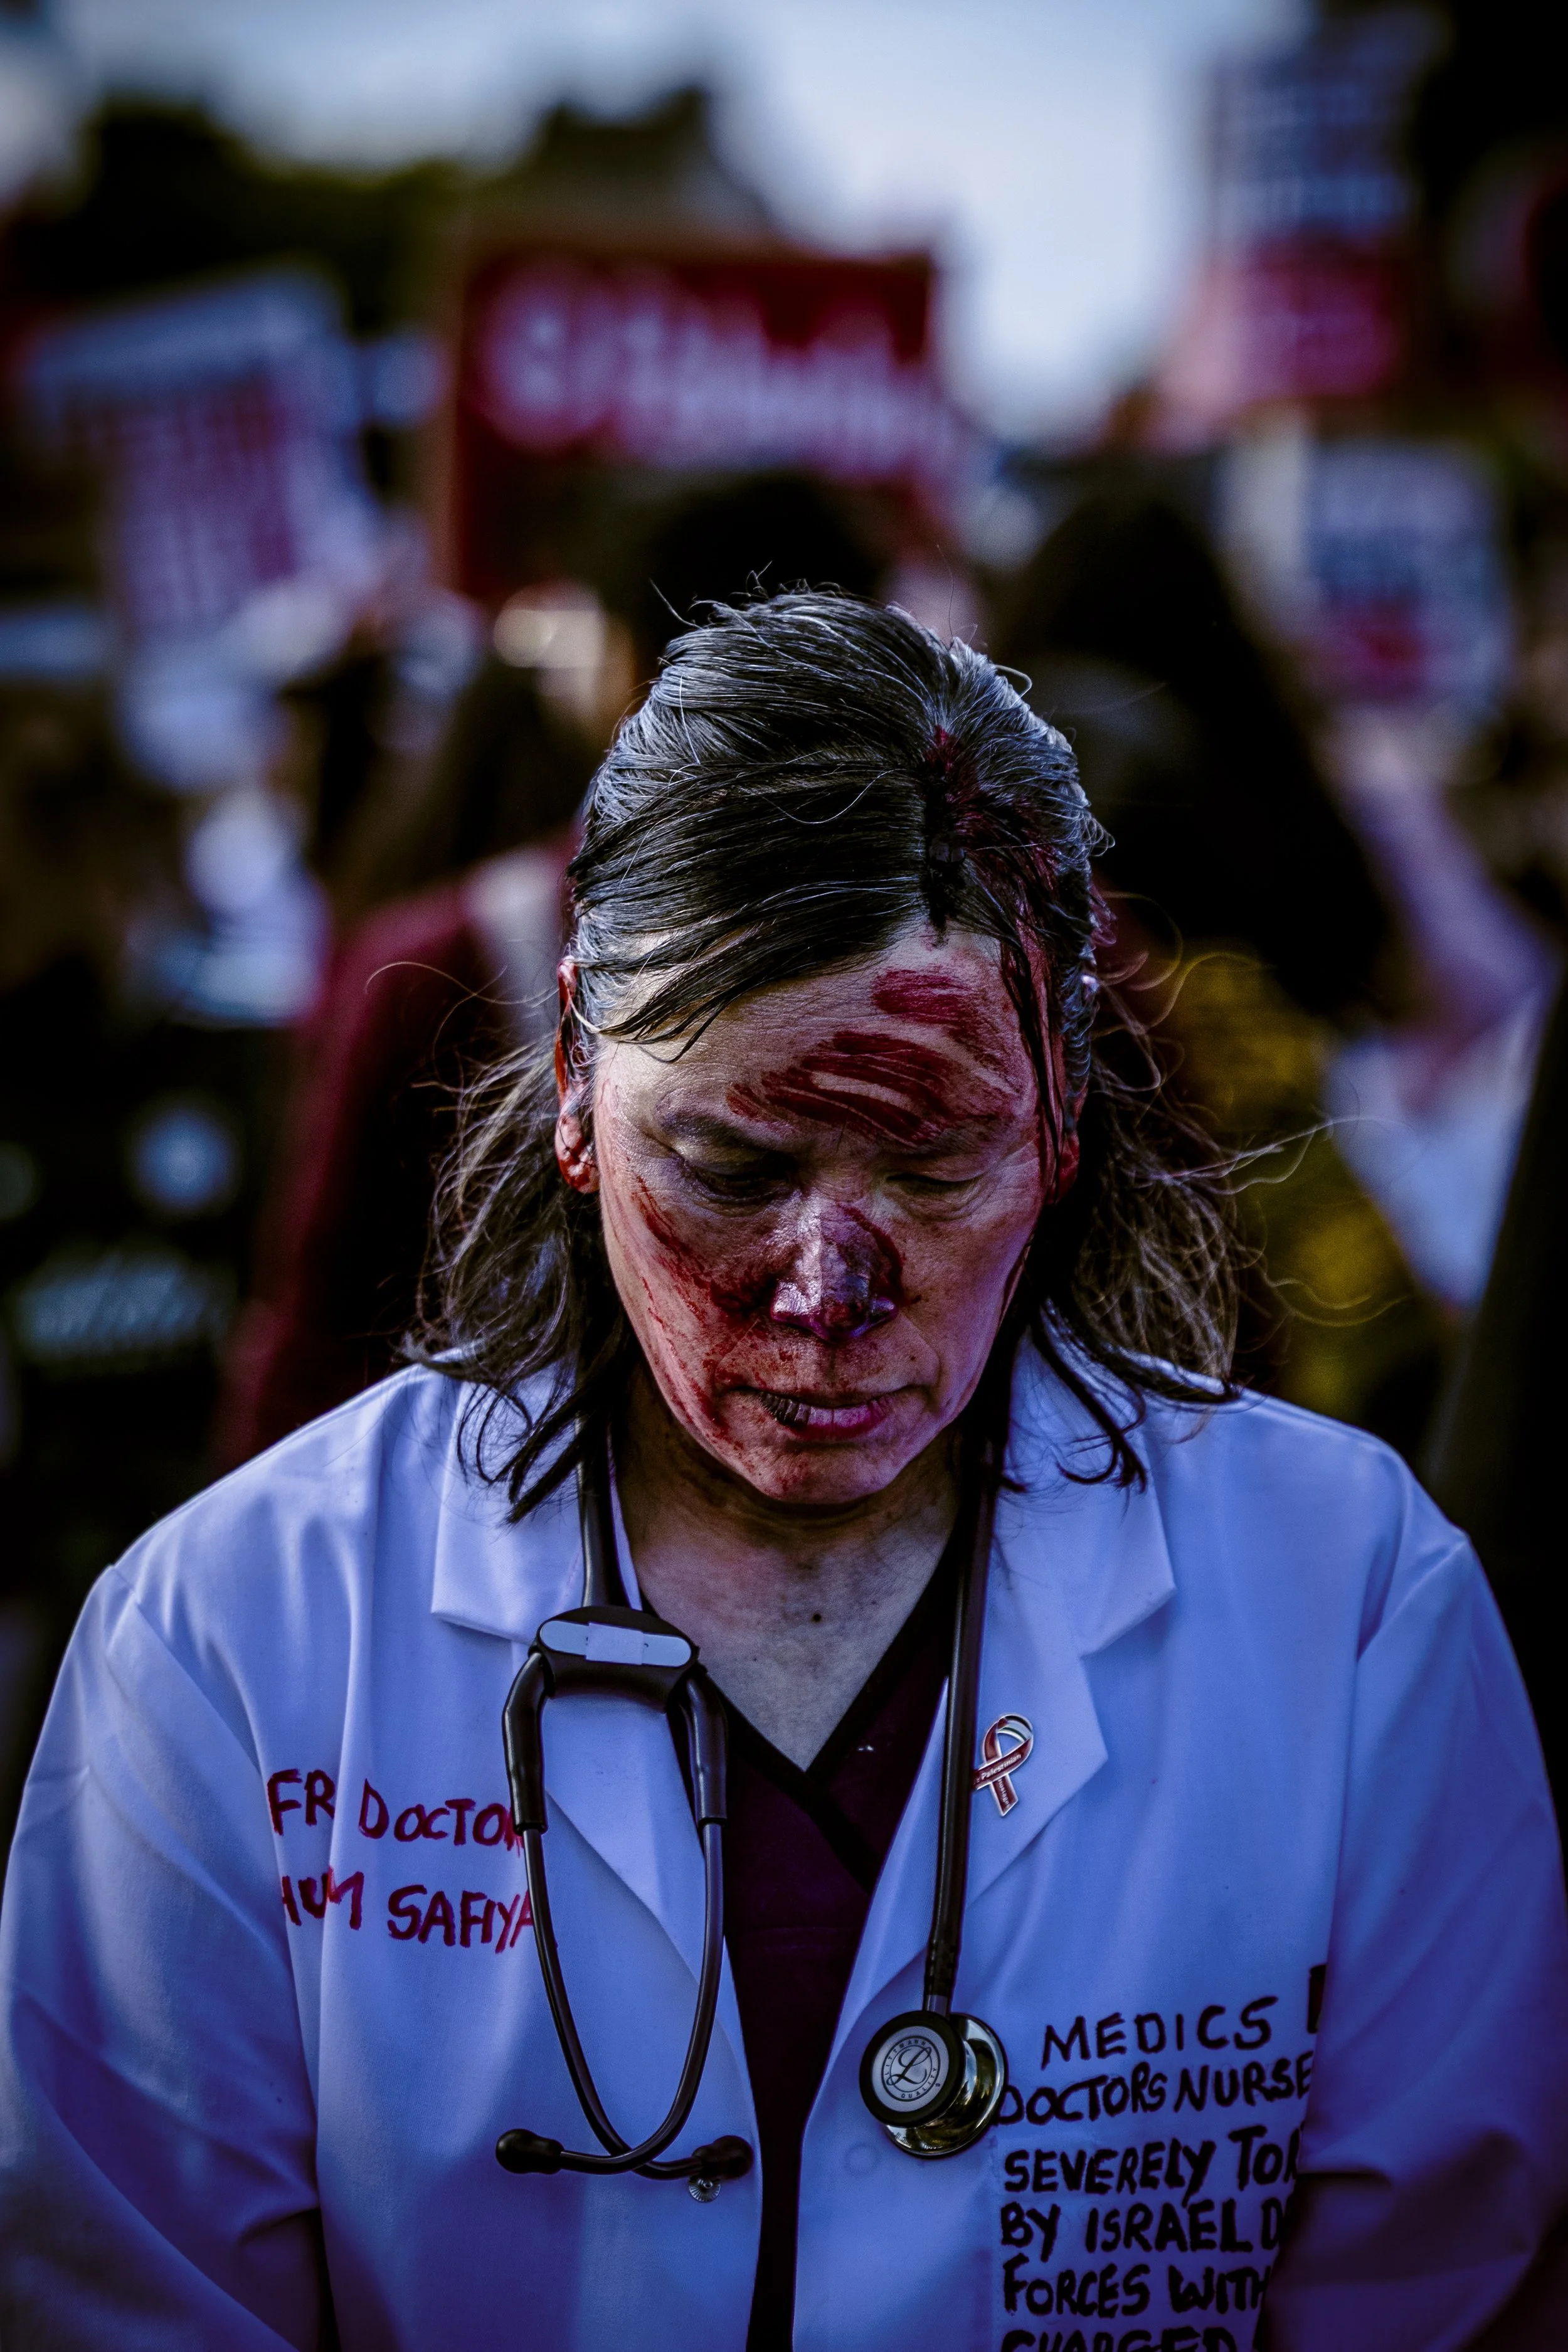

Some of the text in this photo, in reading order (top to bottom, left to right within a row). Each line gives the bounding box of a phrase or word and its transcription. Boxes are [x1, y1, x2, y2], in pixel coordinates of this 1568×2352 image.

[1041, 1996, 1279, 2069] MEDICS
[901, 2068, 937, 2098] QUALITY
[996, 2062, 1167, 2125] DOCTORS
[1004, 2137, 1216, 2208] SEVERELY
[1000, 2201, 1061, 2262] BY
[1085, 2196, 1253, 2253] ISRAEL
[1003, 2253, 1151, 2318] FORCES
